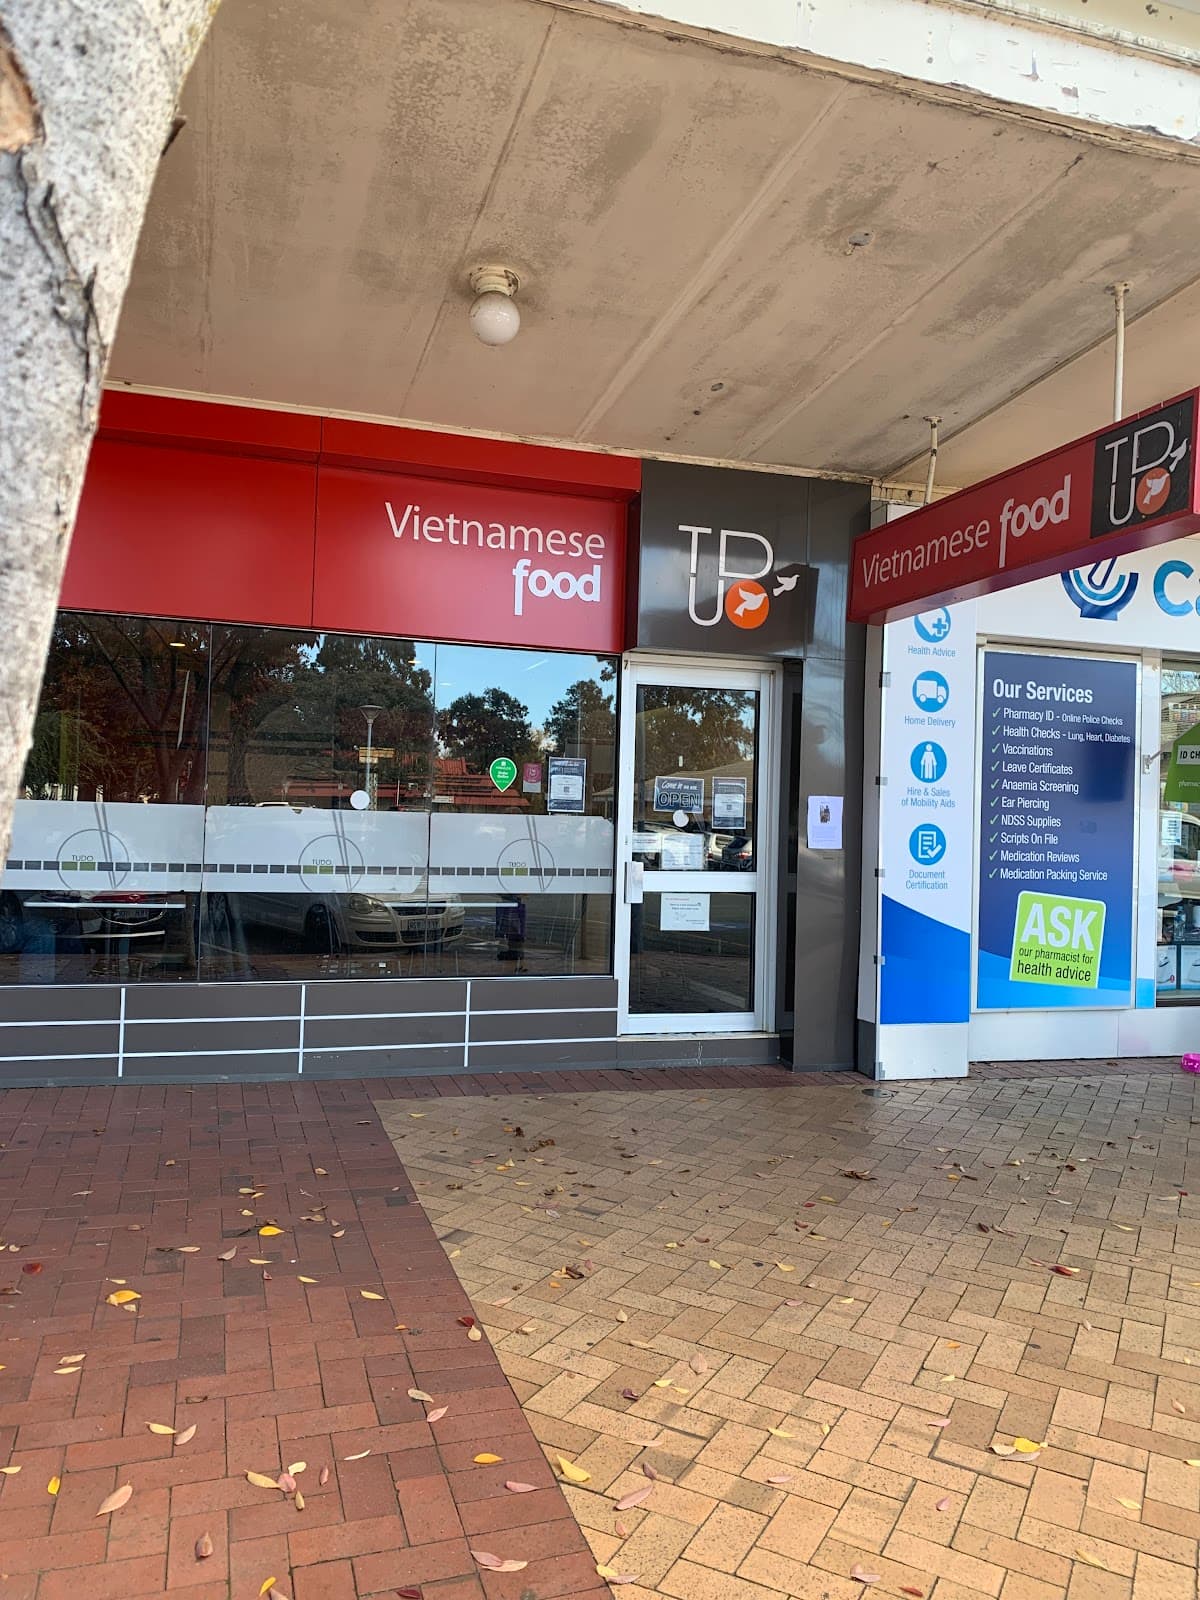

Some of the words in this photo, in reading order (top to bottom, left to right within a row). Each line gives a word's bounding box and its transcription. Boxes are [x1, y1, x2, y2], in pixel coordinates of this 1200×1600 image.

[385, 502, 606, 559] Vietnamese
[862, 519, 990, 588] Vietnamese
[999, 473, 1071, 568] food
[512, 558, 601, 616] food
[1153, 560, 1200, 617] C
[908, 645, 930, 656] Health
[932, 646, 956, 657] Advice
[993, 678, 1022, 699] Our
[1026, 680, 1093, 703] Services
[904, 715, 926, 726] Home
[928, 716, 956, 728] Delivery
[1003, 707, 1043, 722] Pharmacy
[1045, 710, 1054, 721] ID
[1061, 713, 1081, 723] Online
[1082, 714, 1100, 724] Police
[1101, 715, 1123, 726] Checks
[1003, 725, 1029, 737] Health
[1031, 726, 1061, 739] Checks
[1067, 731, 1084, 743] Lung,
[1086, 732, 1103, 743] Heart,
[1105, 733, 1131, 743] Diabetes
[1002, 743, 1053, 757] Vaccinations
[1179, 751, 1188, 759] ID
[1002, 761, 1027, 773] Leave
[1028, 762, 1073, 775] Certificates
[906, 787, 922, 796] Hire
[924, 787, 930, 796] &
[931, 787, 951, 797] Sales
[1001, 780, 1037, 791] Anaemia
[1039, 780, 1079, 794] Screening
[659, 791, 699, 807] OPEN
[901, 798, 909, 806] of
[910, 798, 938, 809] Mobility
[940, 799, 956, 808] Aids
[1001, 797, 1014, 808] Ear
[1017, 797, 1050, 811] Piercing
[1001, 814, 1025, 826] NDSS
[1026, 815, 1061, 829] Supplies
[1000, 832, 1029, 845] Scripts
[1031, 833, 1043, 844] On
[1044, 833, 1058, 845] File
[1000, 850, 1045, 862] Medication
[1047, 851, 1080, 863] Reviews
[908, 870, 945, 879] Document
[1000, 868, 1045, 880] Medication
[1046, 869, 1078, 882] Packing
[1079, 869, 1108, 881] Service
[905, 880, 948, 890] Certification
[1020, 902, 1098, 951] ASK
[1018, 947, 1033, 957] our
[1034, 947, 1080, 963] pharmacist
[1082, 953, 1093, 965] for
[1017, 960, 1052, 977] health
[1055, 965, 1091, 982] advice
